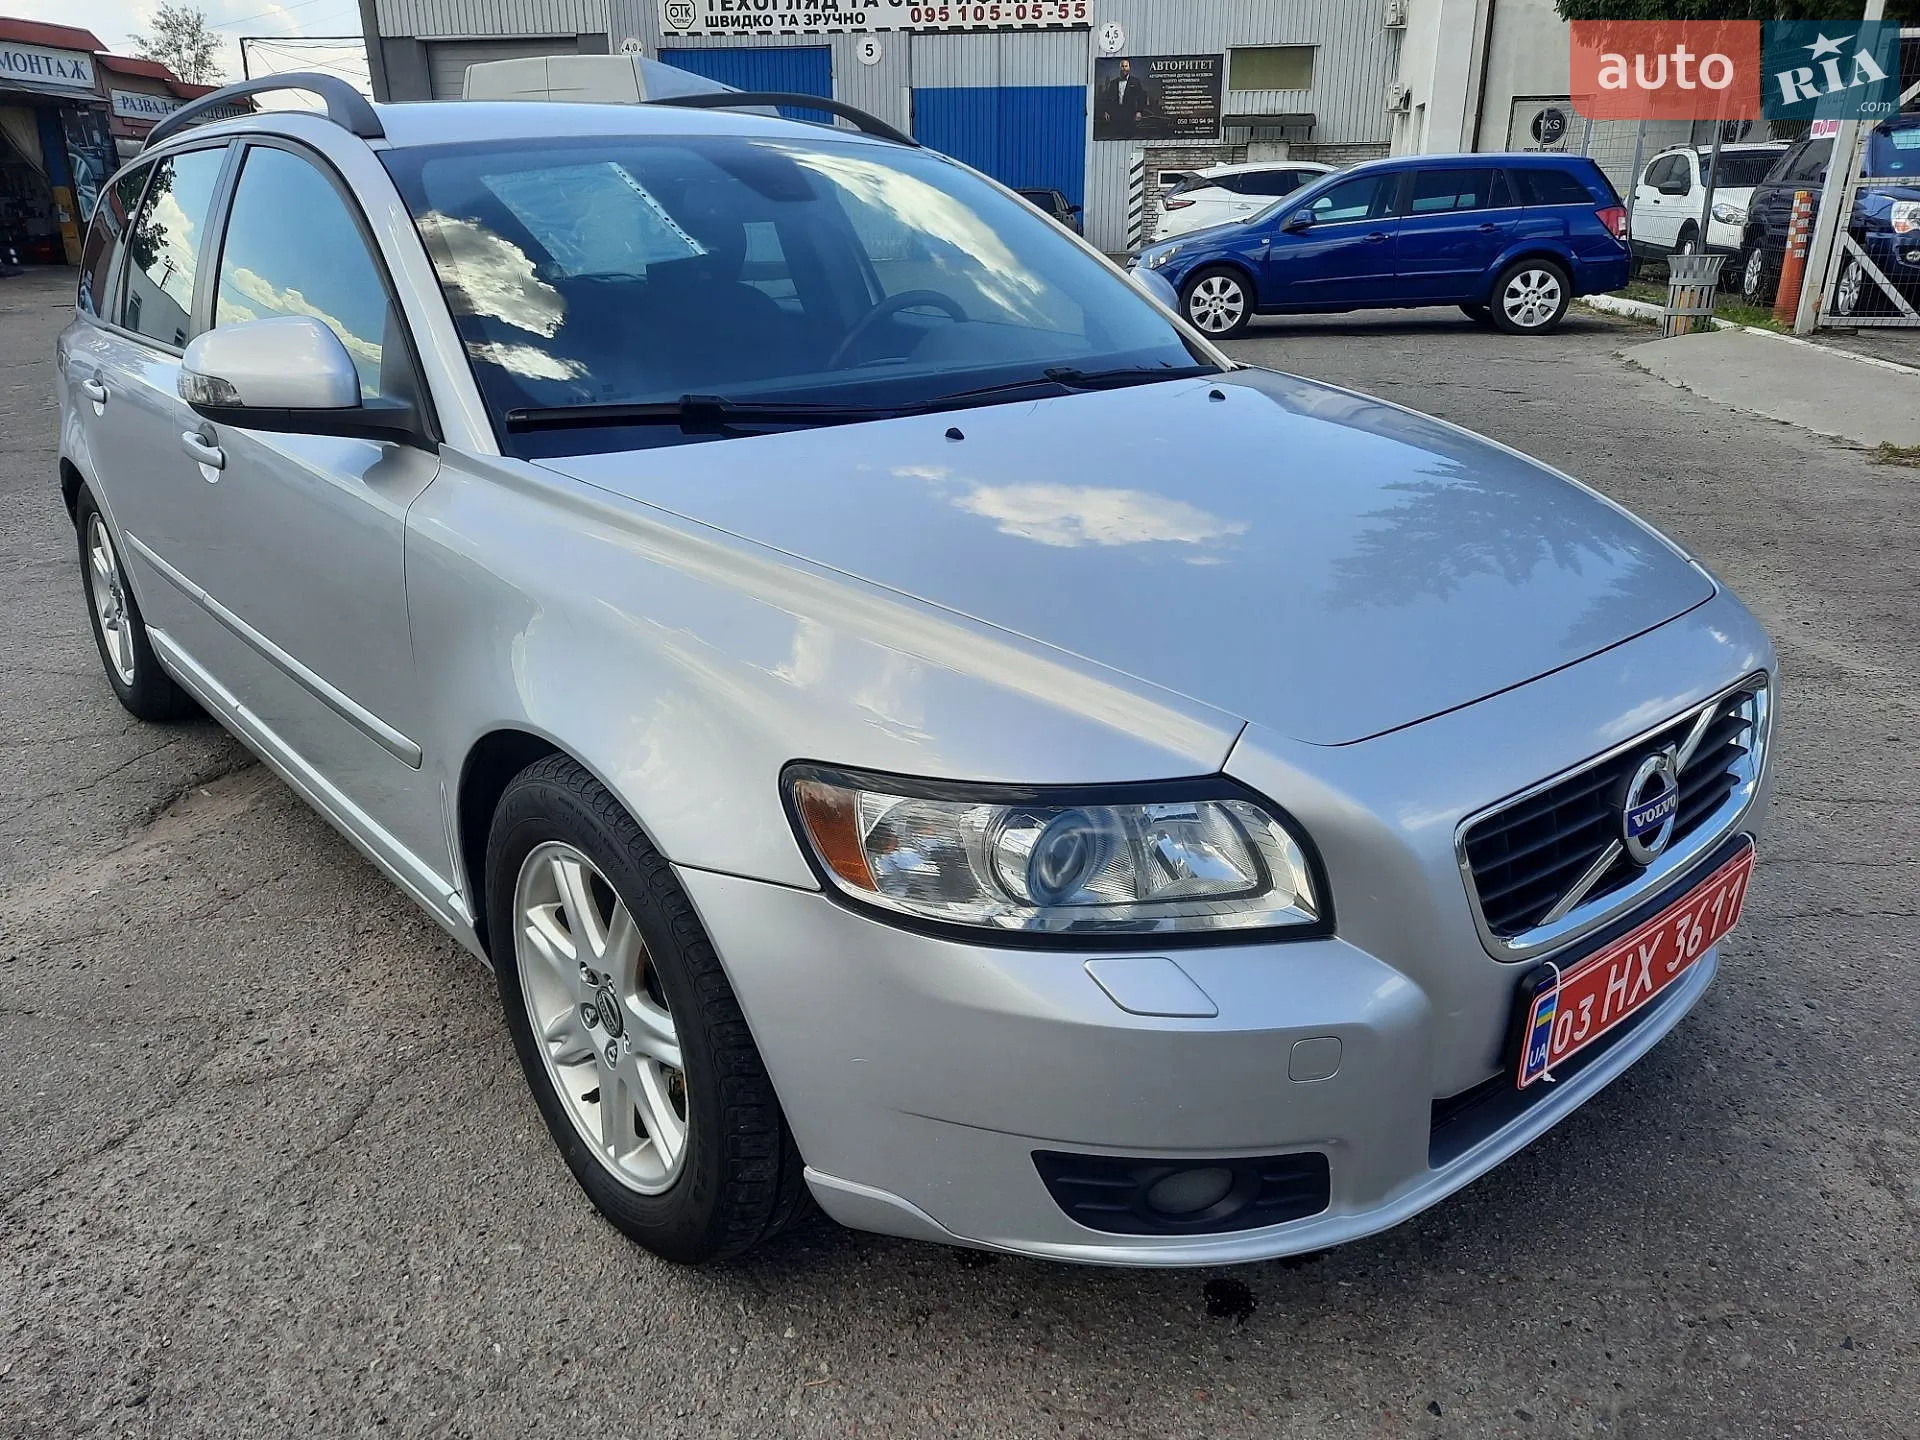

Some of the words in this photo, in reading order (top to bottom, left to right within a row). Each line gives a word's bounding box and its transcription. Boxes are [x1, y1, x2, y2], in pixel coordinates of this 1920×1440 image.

[670, 4, 691, 18] ОТК
[705, 14, 774, 29] ШВИДКО
[778, 13, 799, 26] ТА
[803, 12, 866, 26] ЗРУЧНО
[910, 6, 950, 23] 095
[958, 3, 1086, 21] 105-05-55
[865, 43, 874, 57] 5
[0, 51, 88, 80] МОНТАЖ
[1149, 60, 1214, 71] АВТОРИТЕТ
[1632, 794, 1676, 827] VOLVO
[1553, 993, 1595, 1054] 03
[1601, 930, 1664, 1023] HX
[1667, 872, 1743, 973] 3611
[1529, 1042, 1546, 1068] UA
